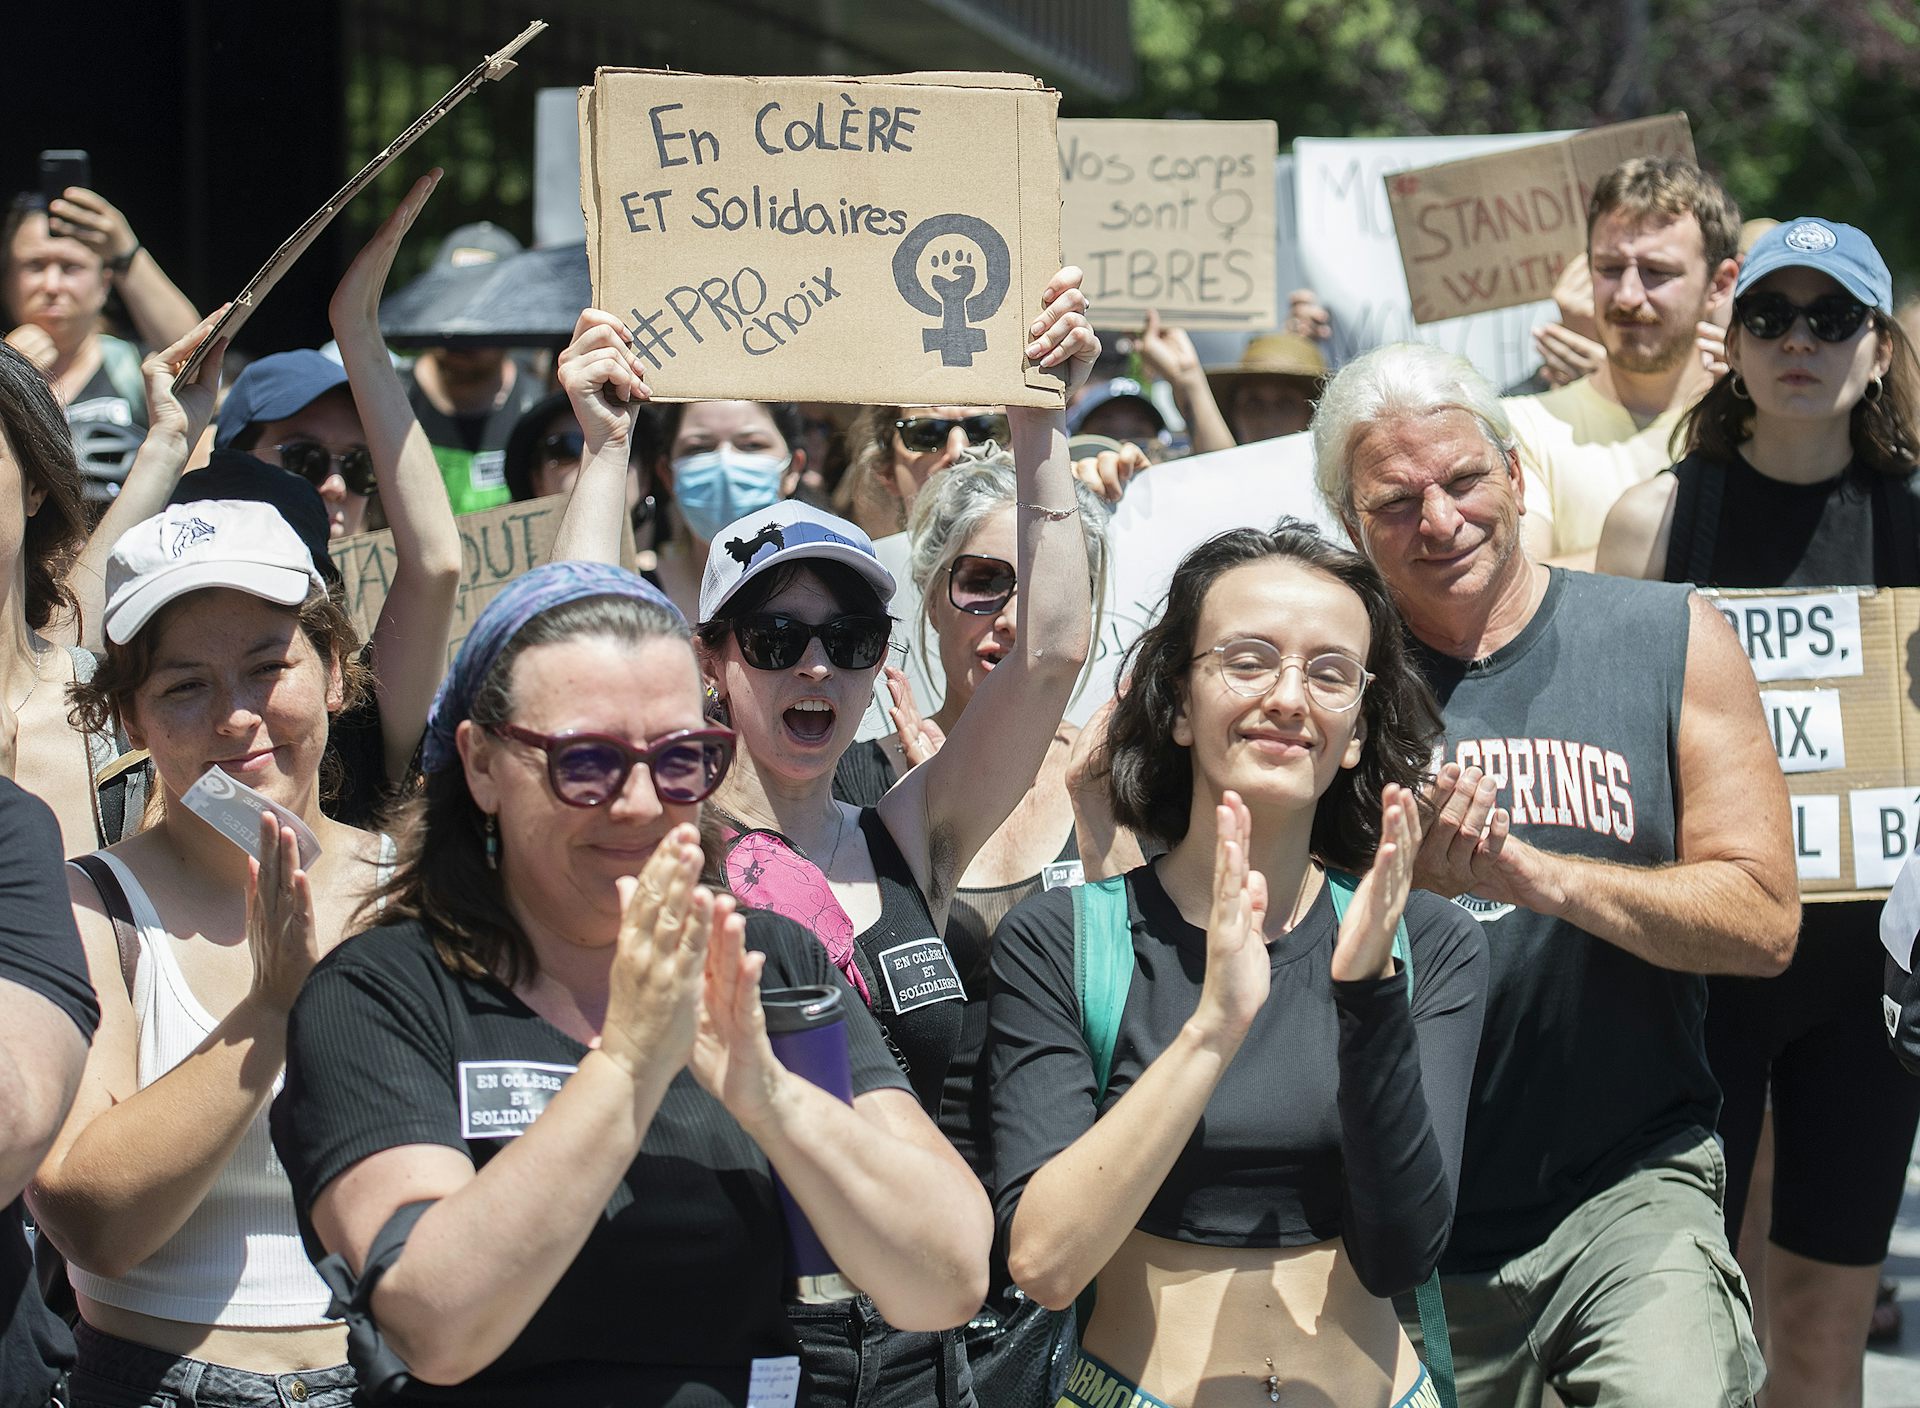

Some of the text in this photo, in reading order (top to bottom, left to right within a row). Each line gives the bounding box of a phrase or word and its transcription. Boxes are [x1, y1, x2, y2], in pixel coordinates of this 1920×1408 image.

[648, 102, 720, 168] En
[1148, 154, 1256, 191] corps
[620, 184, 908, 237] ET Solidaires
[1100, 190, 1199, 231] sont
[1083, 249, 1256, 305] IBRES
[624, 266, 767, 370] #PRO
[893, 955, 911, 970] EN
[921, 965, 937, 978] ET
[476, 1072, 562, 1091] EN COLÈRE
[510, 1091, 533, 1106] ET
[471, 1108, 543, 1125] SOLIDAI
[1066, 1358, 1160, 1408] ARMO
